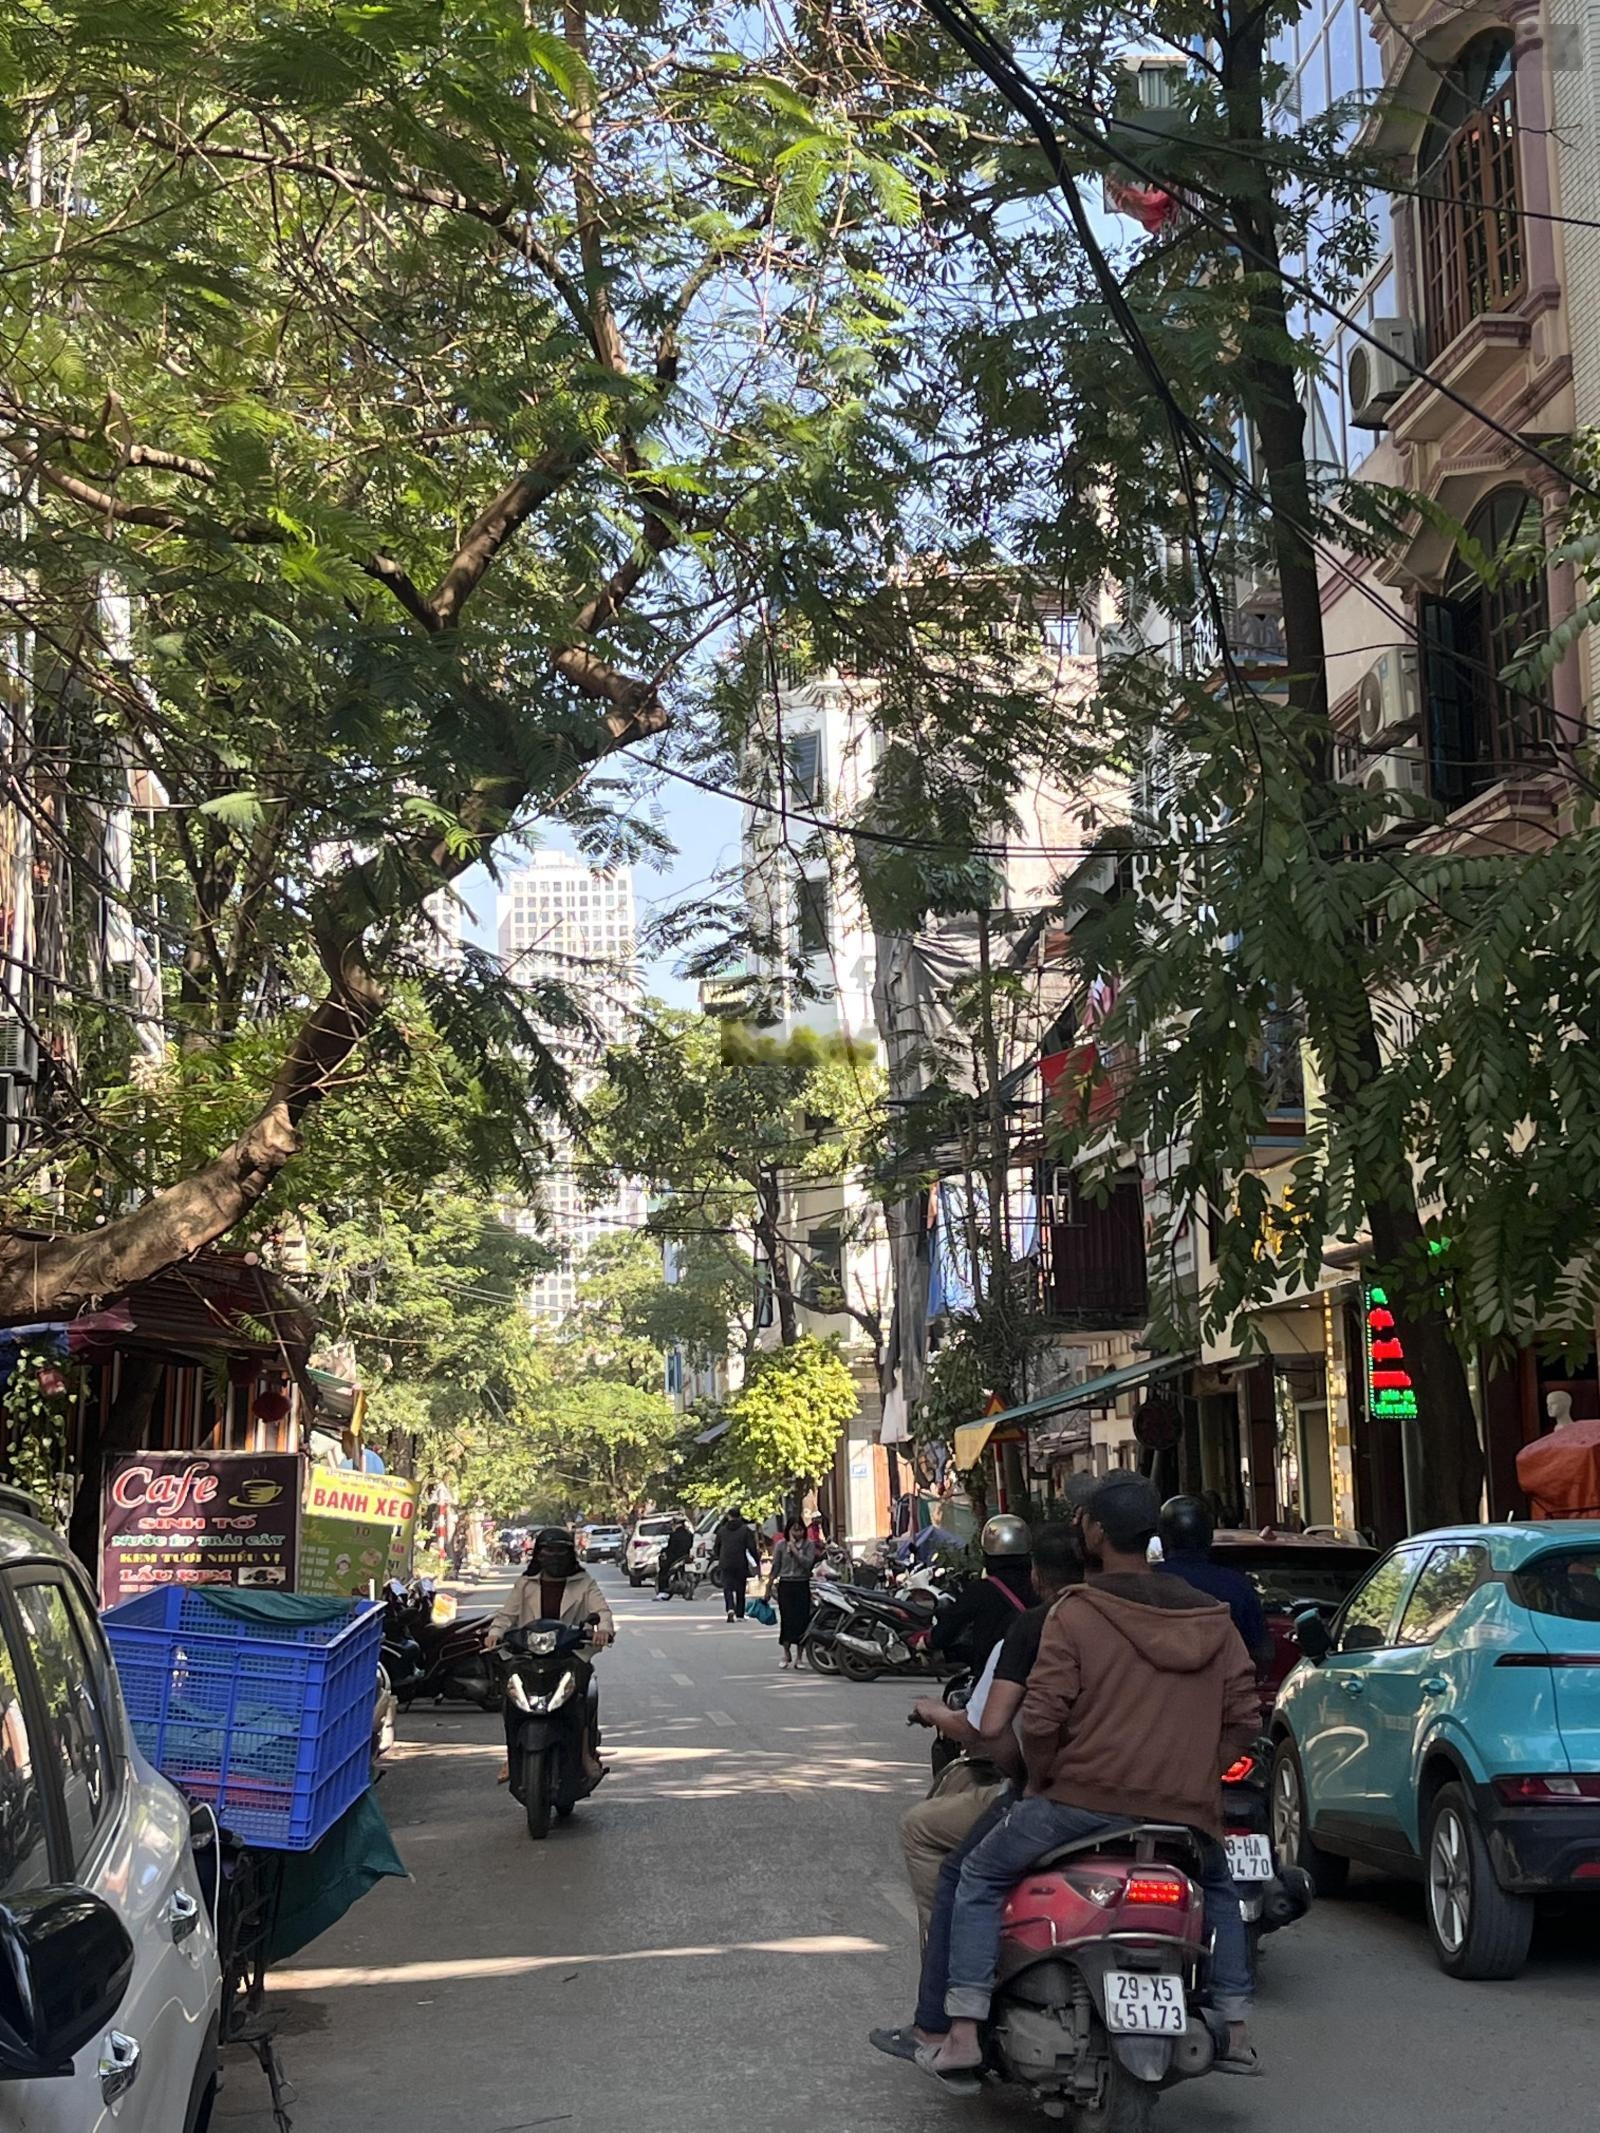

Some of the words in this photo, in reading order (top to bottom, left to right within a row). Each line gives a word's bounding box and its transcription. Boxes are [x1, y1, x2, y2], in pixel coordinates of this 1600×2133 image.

[112, 1461, 219, 1516] Cafe
[138, 1516, 206, 1530] SINH
[119, 1553, 158, 1563] KEM
[1224, 1838, 1262, 1857] 8-HA
[1117, 1975, 1173, 2002] 29-X5
